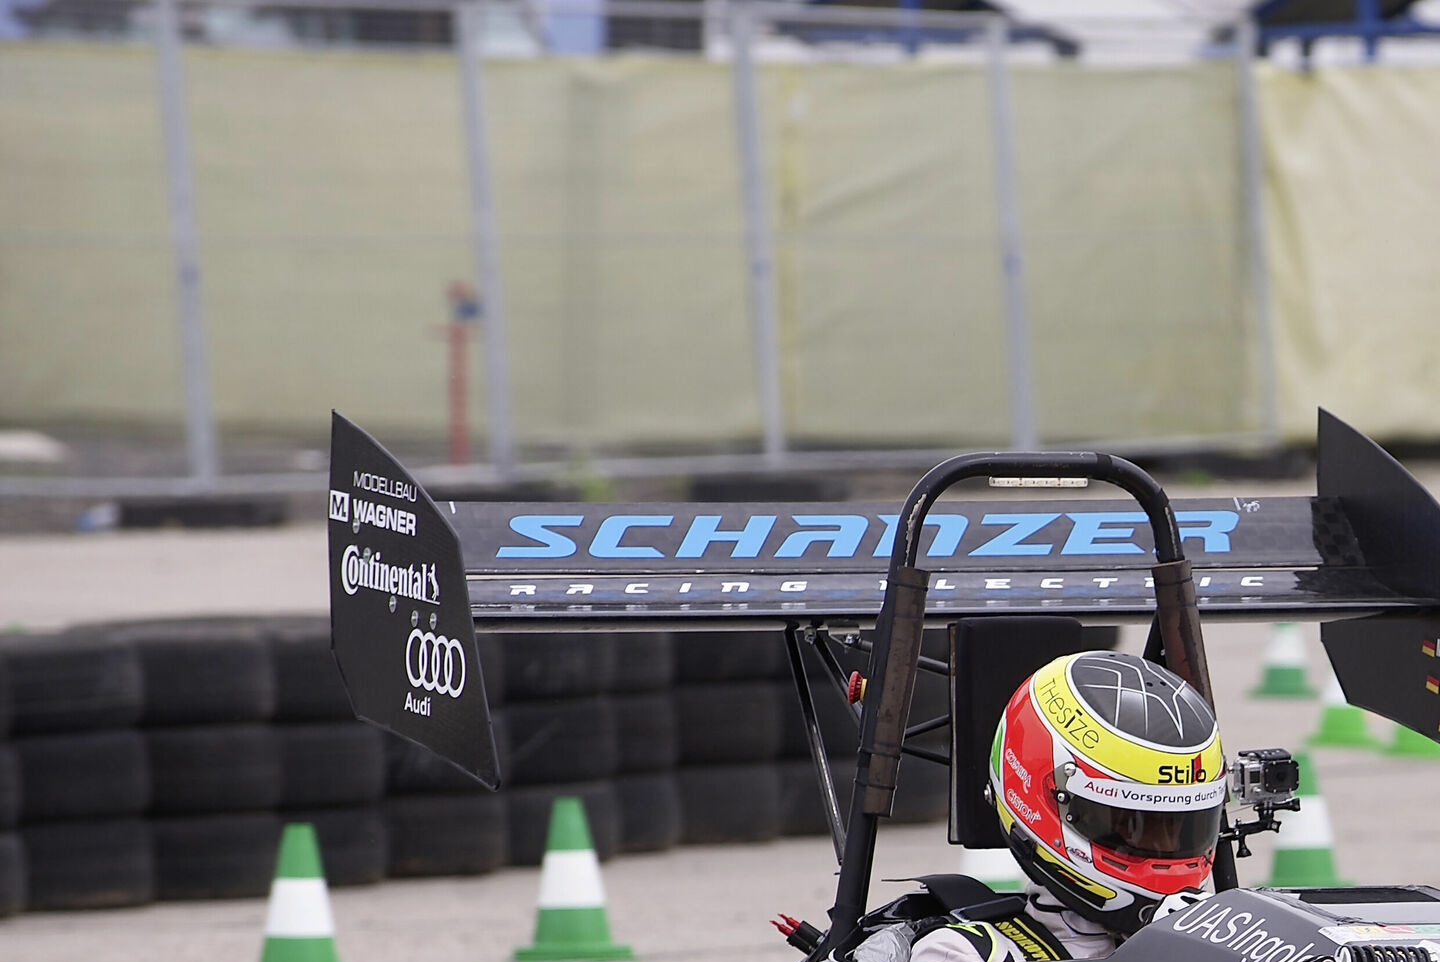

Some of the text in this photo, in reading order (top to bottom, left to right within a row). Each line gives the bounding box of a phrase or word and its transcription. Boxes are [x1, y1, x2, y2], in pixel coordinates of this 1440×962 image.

[353, 471, 418, 502] MODELLBAU
[353, 499, 417, 536] WAGNER
[496, 510, 1240, 558] SCHANZER
[341, 545, 430, 601] Continental
[510, 576, 1264, 596] RACING LECTIC
[404, 692, 431, 717] Audi
[1158, 757, 1207, 784] Stilo
[1084, 781, 1118, 798] Audi
[1121, 789, 1191, 805] Vorsprung
[1194, 790, 1217, 801] durch
